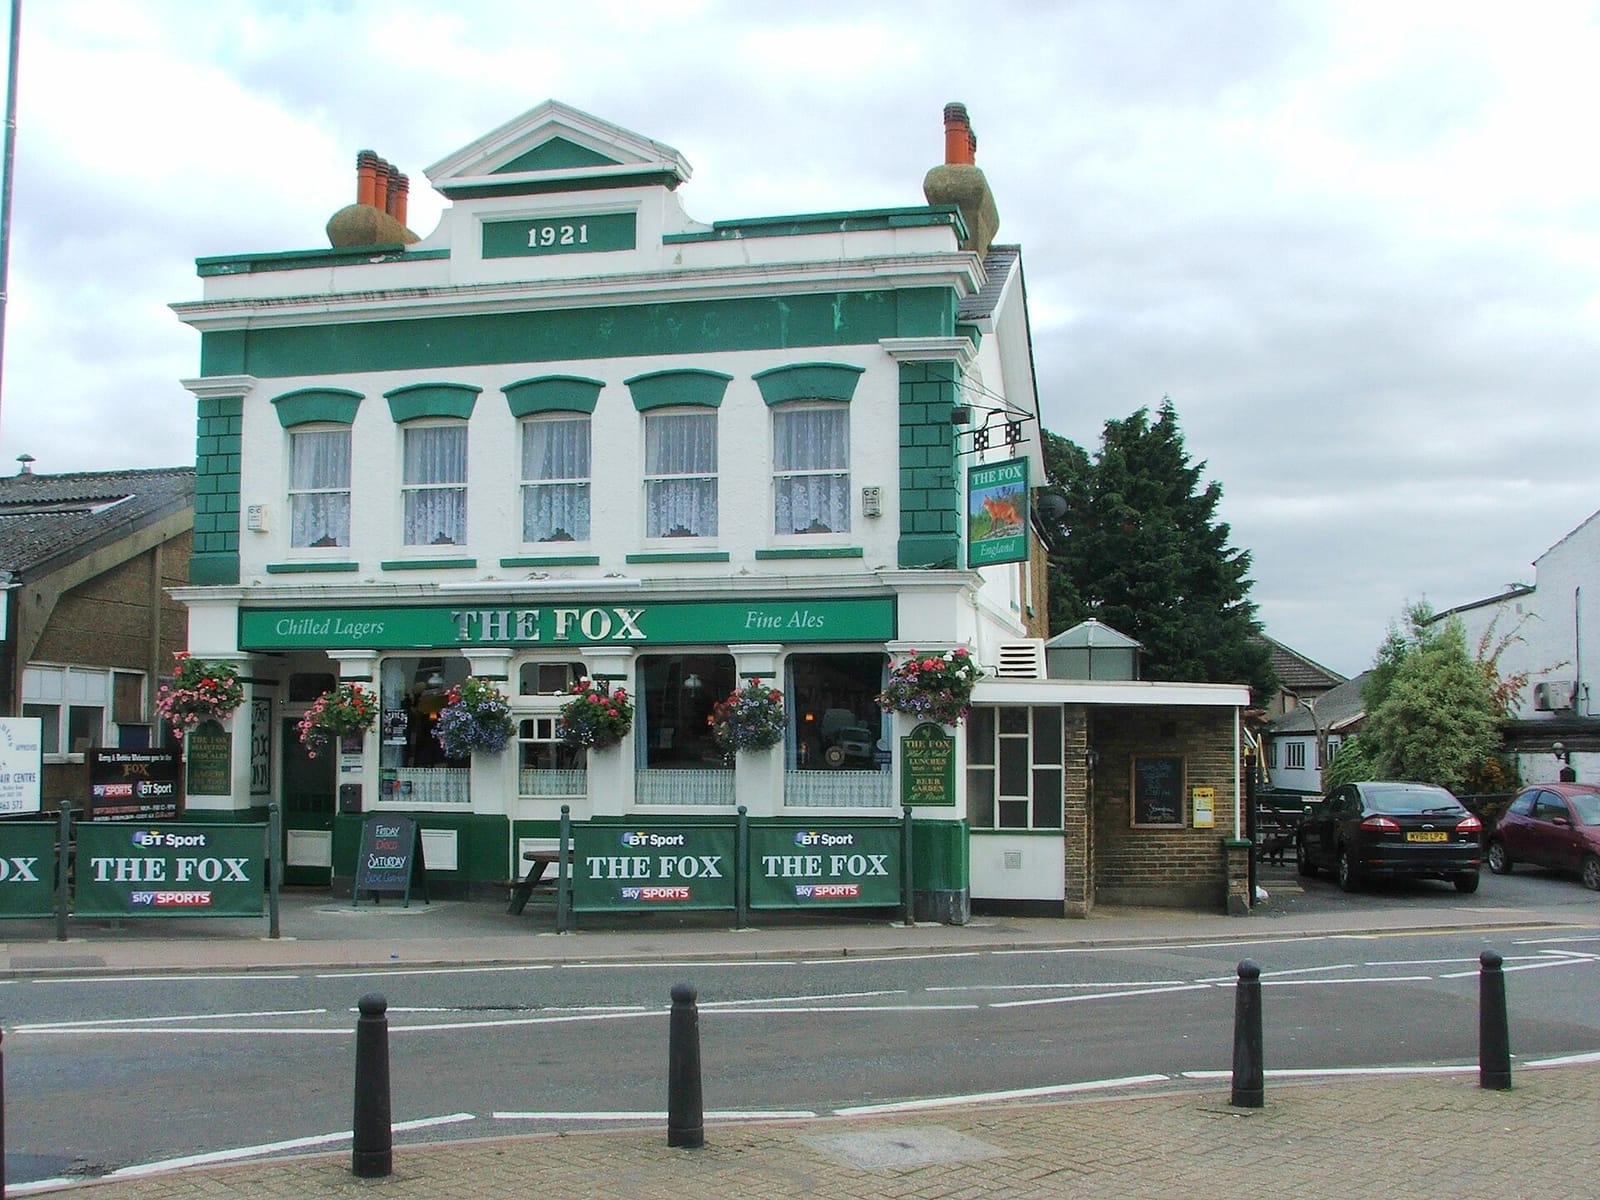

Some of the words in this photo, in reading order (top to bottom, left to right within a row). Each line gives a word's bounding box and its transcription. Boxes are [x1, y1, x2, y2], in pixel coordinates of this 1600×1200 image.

[527, 224, 589, 248] 1921
[972, 471, 996, 485] THE
[998, 465, 1022, 481] FOX
[980, 540, 1015, 558] England
[276, 618, 329, 636] Chilled
[334, 618, 384, 637] Lagers
[451, 609, 541, 641] THE
[553, 608, 647, 641] FOX
[745, 611, 782, 629] Fine
[787, 611, 824, 628] Ales
[905, 740, 925, 749] THE
[929, 740, 951, 749] FOX
[14, 772, 36, 783] CENTRE
[122, 763, 150, 777] FOX
[104, 784, 132, 796] SPORTS
[141, 784, 152, 795] BT
[153, 783, 172, 797] Sport
[911, 785, 945, 793] GARDEN
[141, 835, 163, 846] BT
[165, 833, 206, 848] Sport
[629, 833, 648, 846] BT
[650, 833, 684, 848] Sport
[802, 833, 819, 846] BT
[821, 832, 854, 847] Sport
[90, 858, 166, 882] THE
[175, 857, 250, 882] FOX
[586, 857, 651, 879] THE
[658, 856, 722, 878] FOX
[762, 856, 822, 878] THE
[829, 855, 889, 876] FOX
[621, 887, 641, 900] sky
[642, 886, 690, 899] SPORTS
[796, 885, 813, 898] sky
[814, 884, 858, 897] SPORTS
[132, 892, 154, 906] sky
[156, 892, 211, 904] SPORTS
